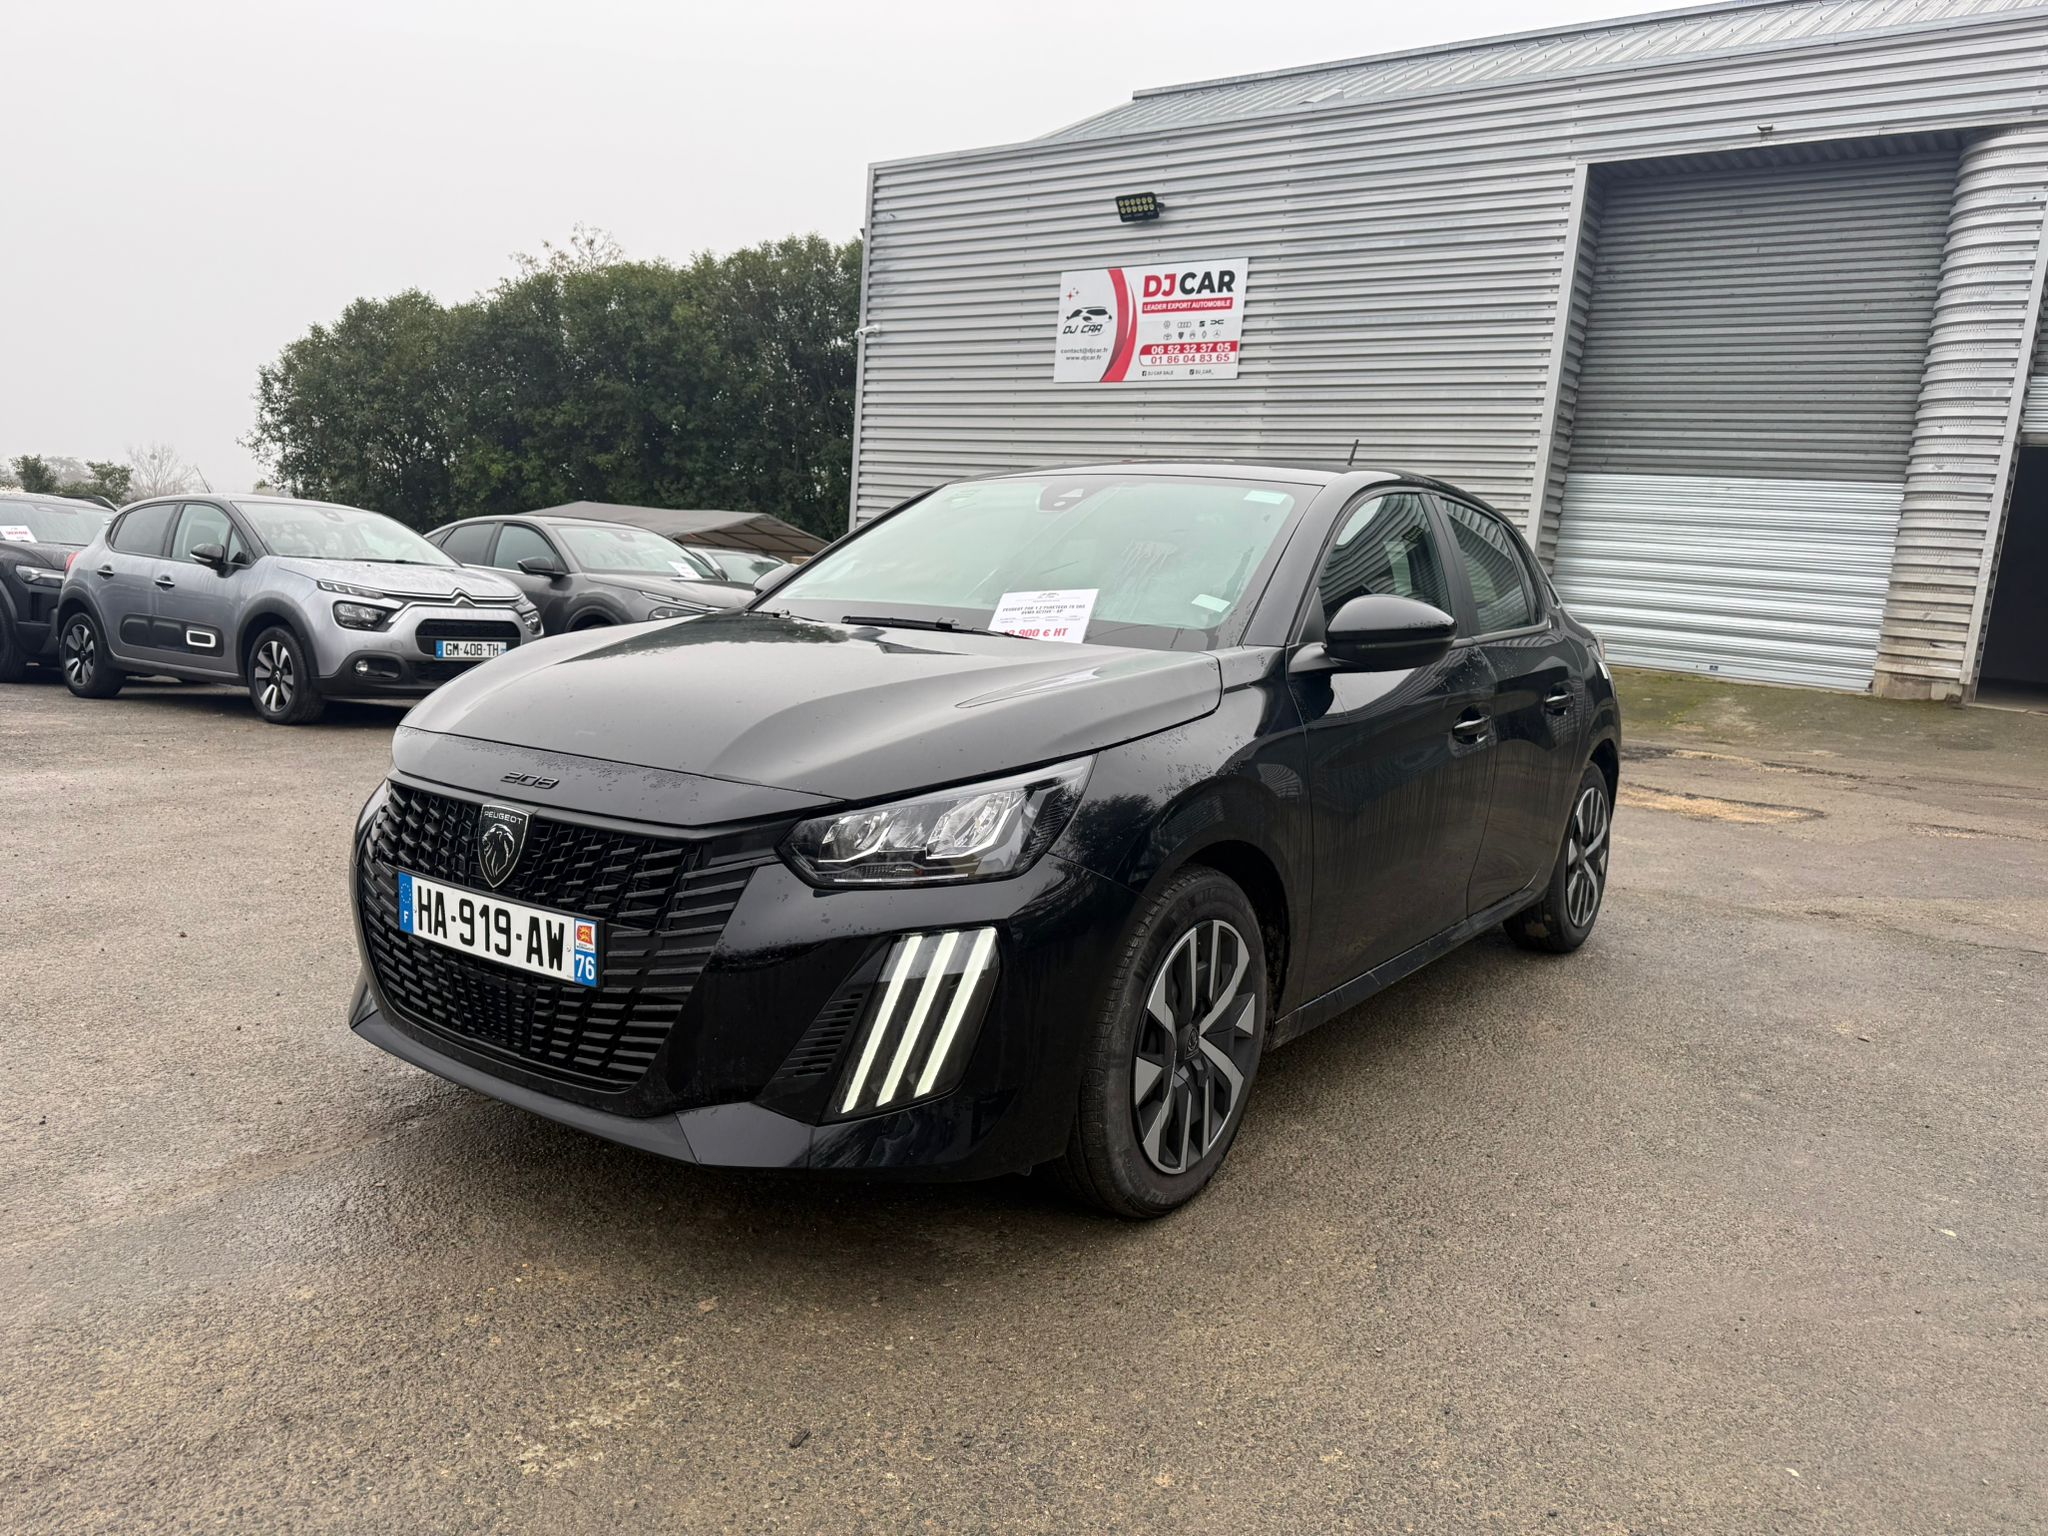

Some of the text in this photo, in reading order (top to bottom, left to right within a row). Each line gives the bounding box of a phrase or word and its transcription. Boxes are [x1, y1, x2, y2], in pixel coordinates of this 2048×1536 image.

[1143, 300, 1231, 311] LEADER EXPORT AUTOMOBILE
[1060, 347, 1108, 355] contact@djcar.fr
[1151, 342, 1231, 354] 06 52 32 37 05
[1066, 354, 1102, 362] www.djcar.fr
[1151, 353, 1230, 364] 01 86 04 83 65
[1018, 629, 1040, 637] 900
[1043, 629, 1051, 637] €
[1053, 628, 1069, 637] HT
[445, 643, 499, 656] GM-408-TH
[500, 771, 560, 790] 208
[483, 810, 523, 825] PEUGEOT
[402, 911, 409, 924] F
[416, 885, 565, 972] HA-919-AW
[575, 953, 596, 981] 76
